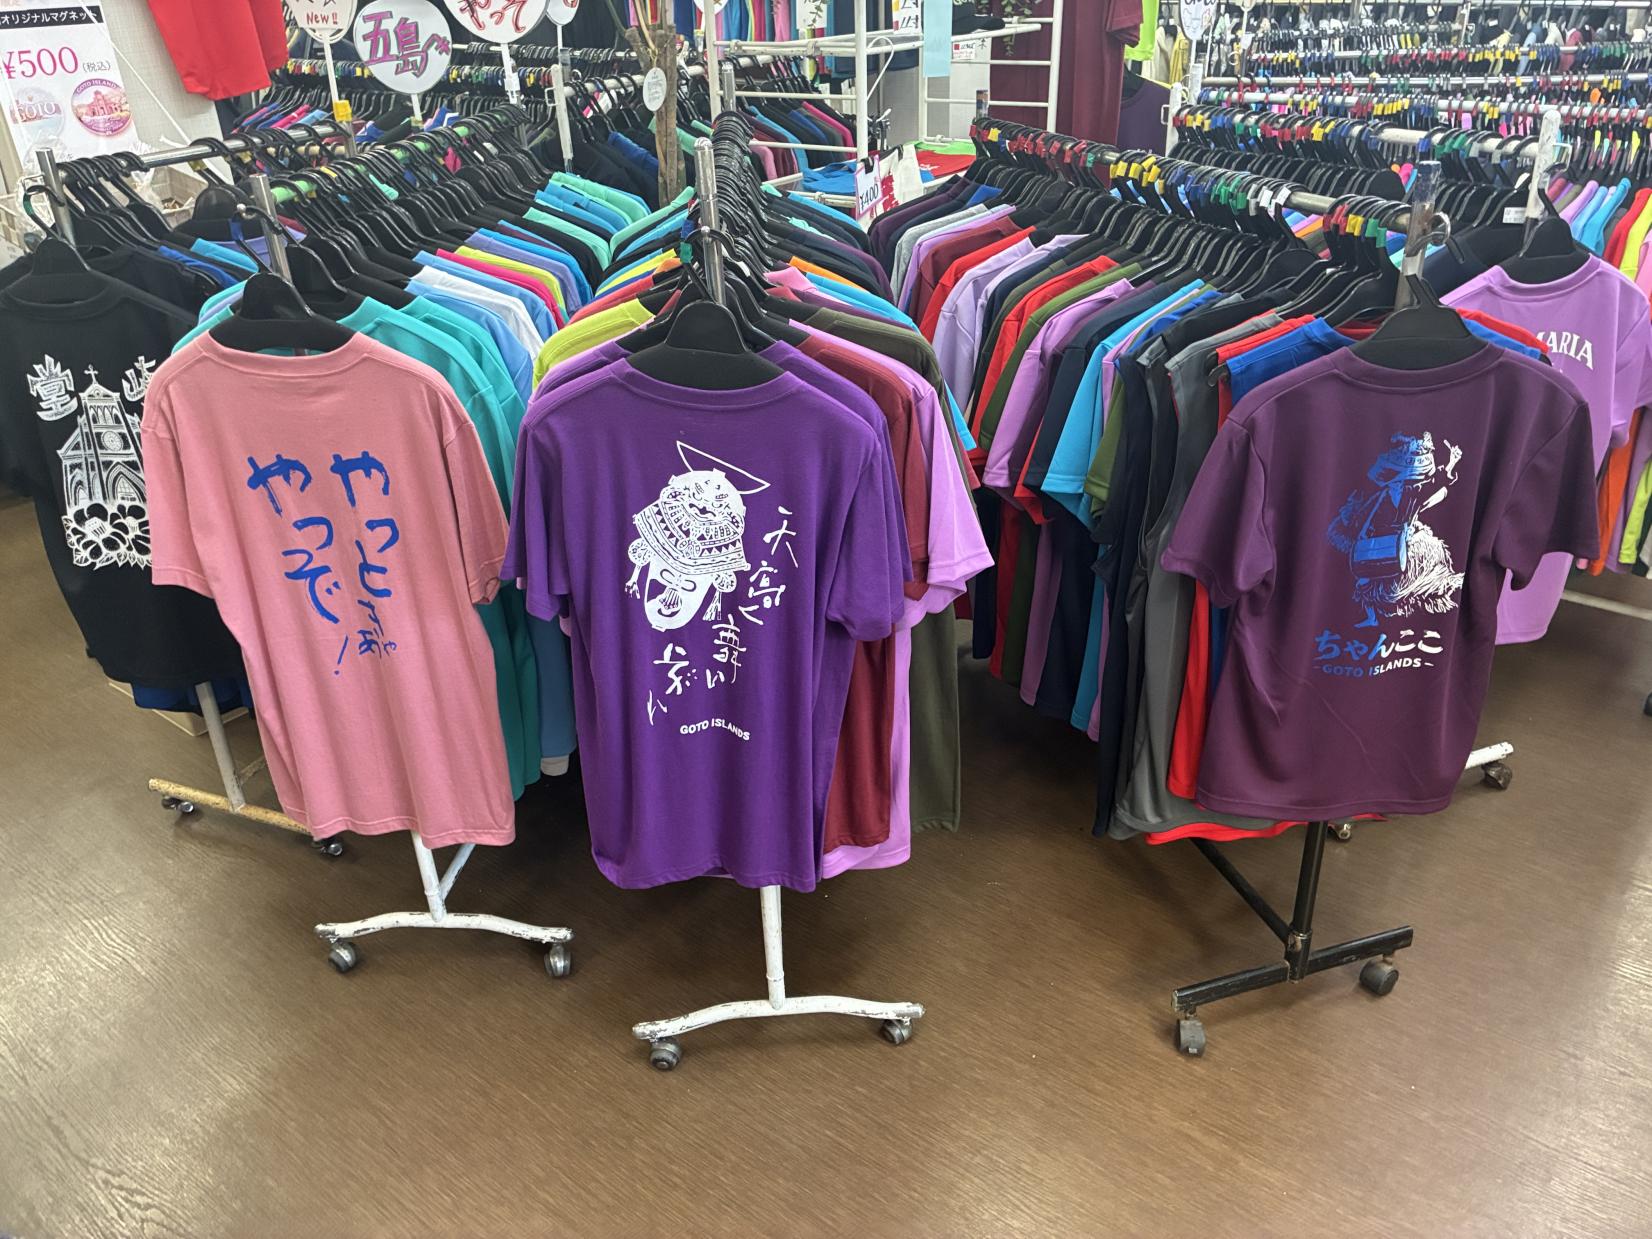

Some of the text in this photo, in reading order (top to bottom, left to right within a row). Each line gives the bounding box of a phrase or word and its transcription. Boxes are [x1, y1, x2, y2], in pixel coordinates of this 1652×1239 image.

[362, 11, 450, 78] 五島へ
[2, 46, 79, 79] ¥500
[860, 183, 879, 210] ¥400
[1537, 331, 1594, 370] ARIA
[1314, 629, 1443, 661] ちゃんここ
[680, 718, 750, 741] GOTO ISLANDS
